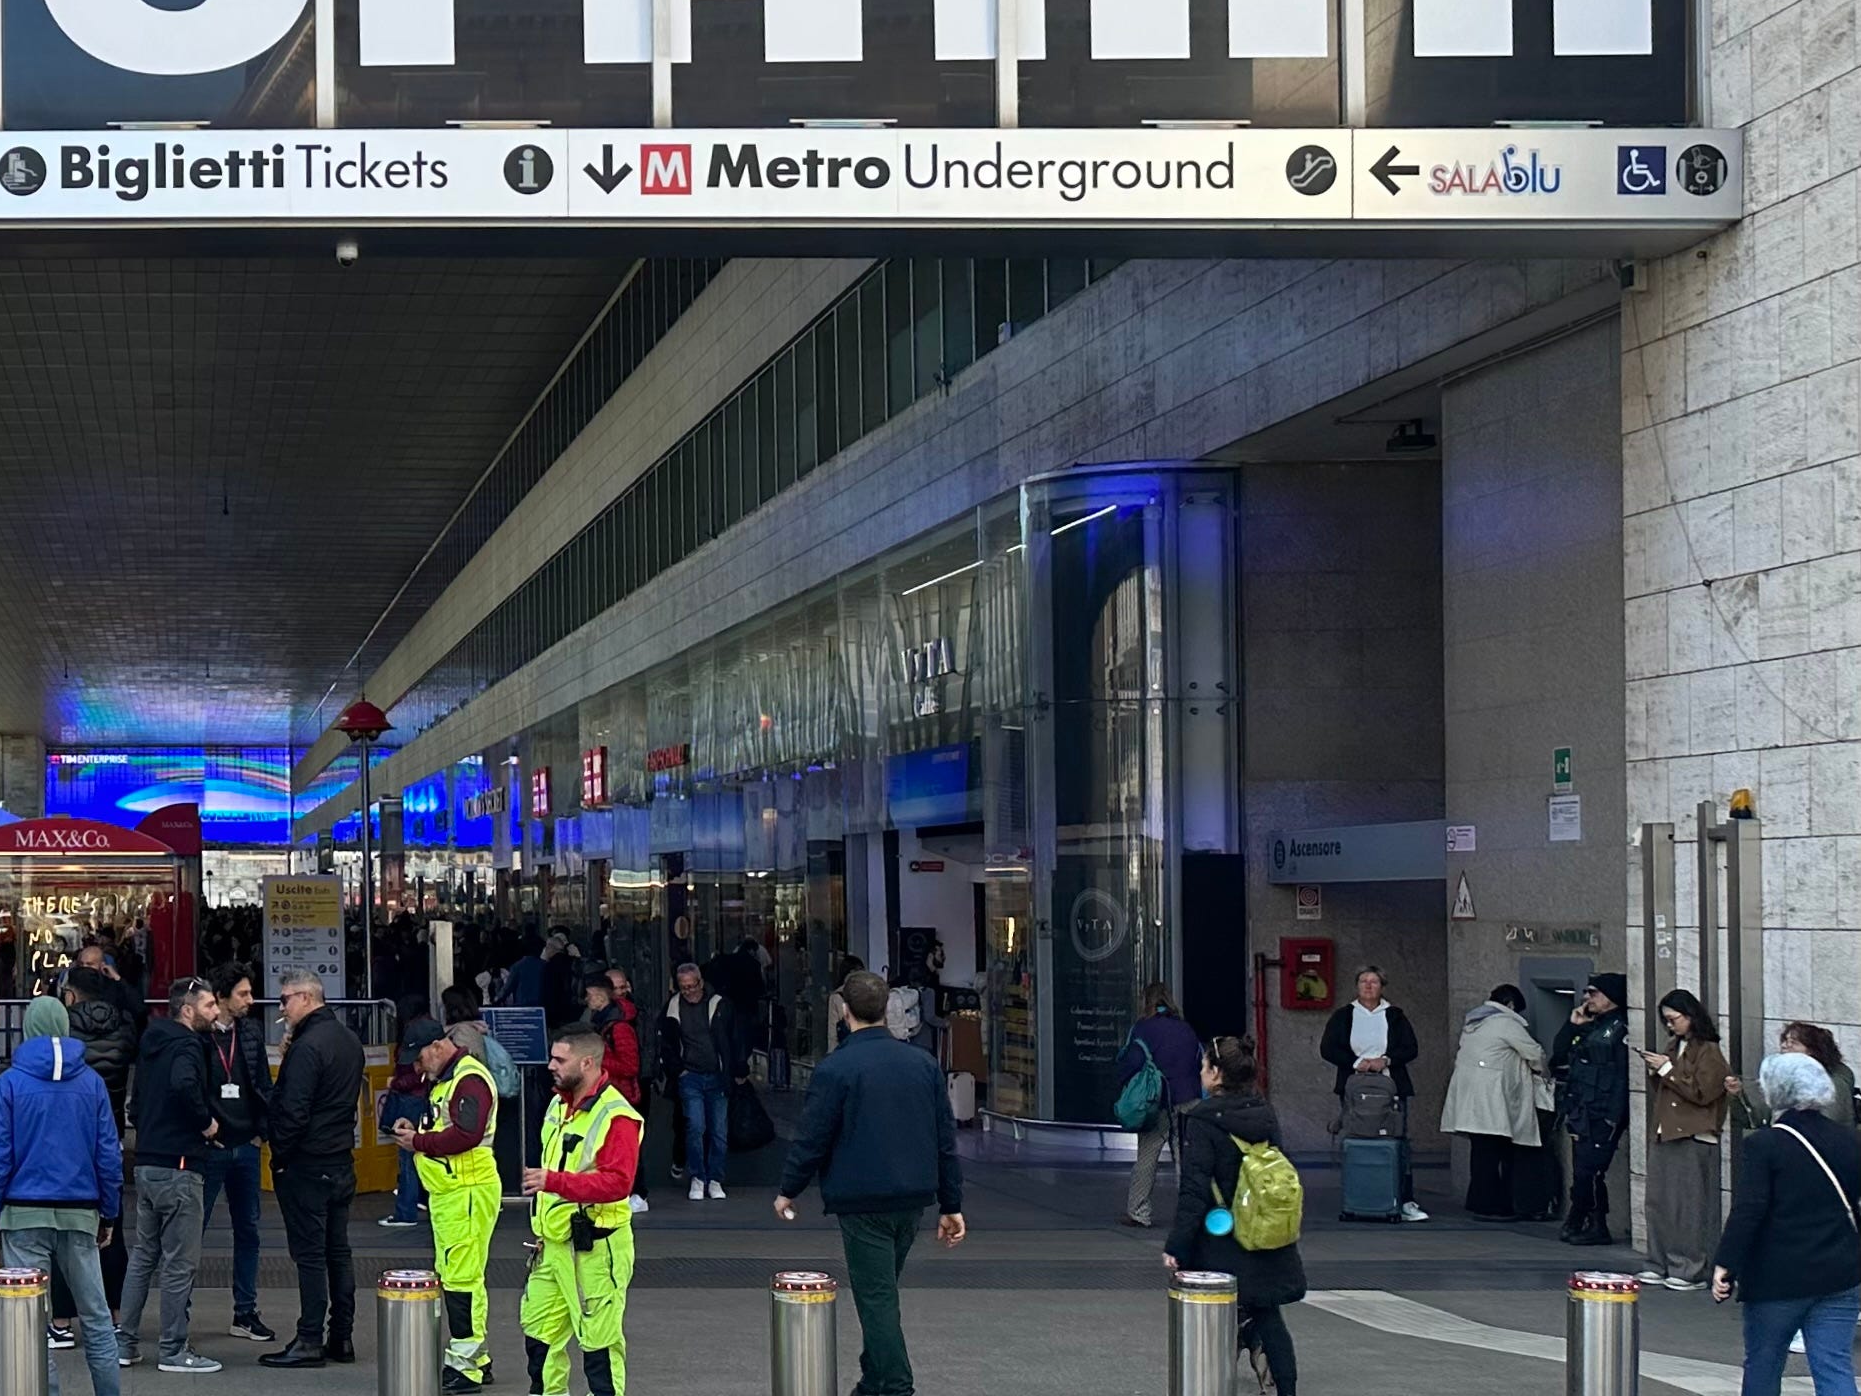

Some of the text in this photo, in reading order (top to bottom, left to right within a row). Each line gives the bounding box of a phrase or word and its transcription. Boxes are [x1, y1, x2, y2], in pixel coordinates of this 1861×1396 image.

[60, 141, 449, 202] Biglietti Tickets
[706, 143, 891, 190] Metro
[904, 141, 1235, 202] Underground
[14, 829, 111, 848] MAX&Co.
[1289, 839, 1342, 858] Ascensore
[276, 884, 313, 895] Uscite
[31, 950, 73, 972] PLA
